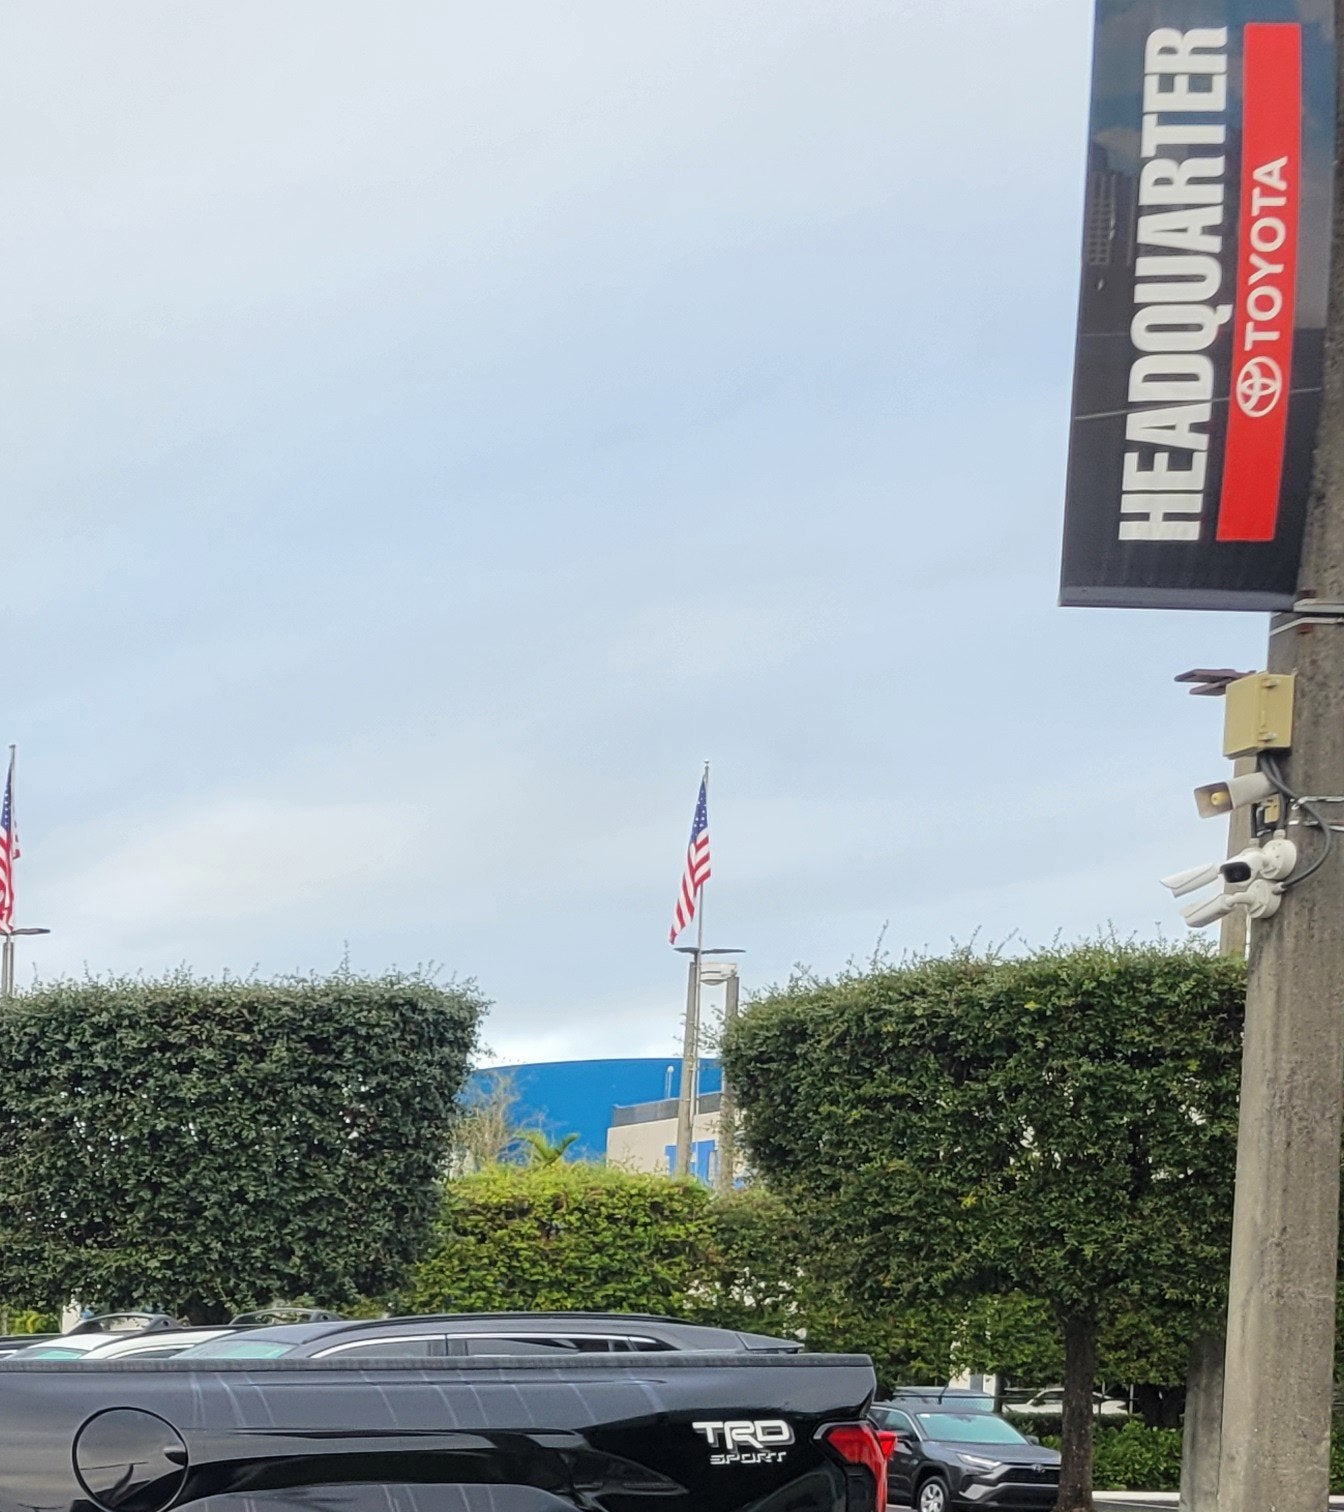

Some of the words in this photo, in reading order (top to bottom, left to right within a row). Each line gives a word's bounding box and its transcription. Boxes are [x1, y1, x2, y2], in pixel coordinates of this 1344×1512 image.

[1118, 25, 1233, 541] HEADQUARTER
[1244, 155, 1289, 352] TOYOTA
[692, 1420, 795, 1450] TRD
[710, 1451, 787, 1465] SPORT
